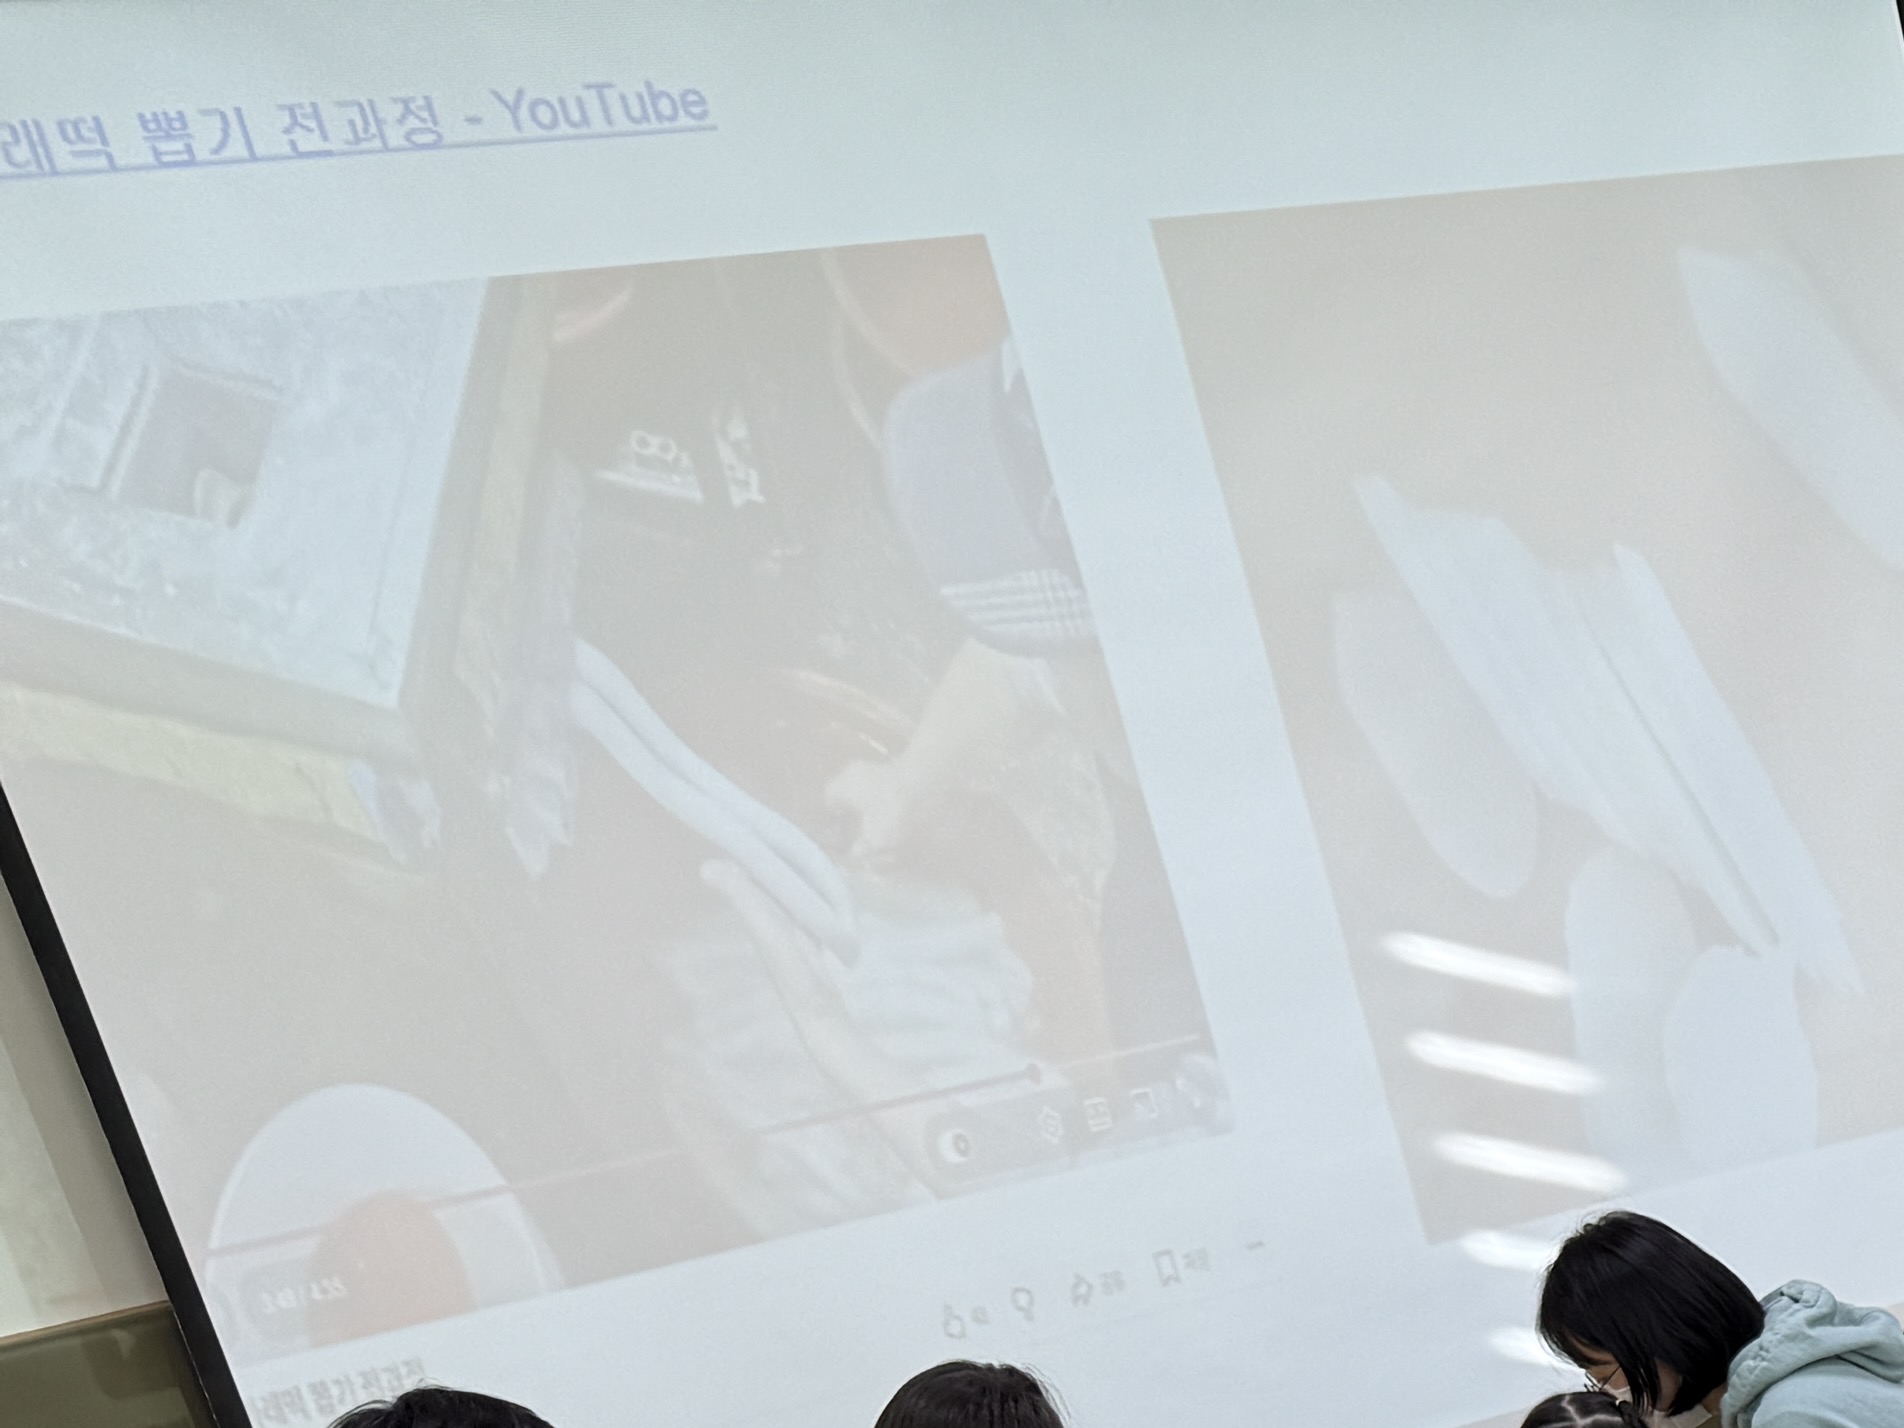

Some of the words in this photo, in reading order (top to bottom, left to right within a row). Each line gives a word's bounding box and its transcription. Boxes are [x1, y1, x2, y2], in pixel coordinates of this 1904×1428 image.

[137, 106, 258, 168] 뽑기
[276, 95, 444, 157] 전과정
[489, 79, 710, 133] YouTube
